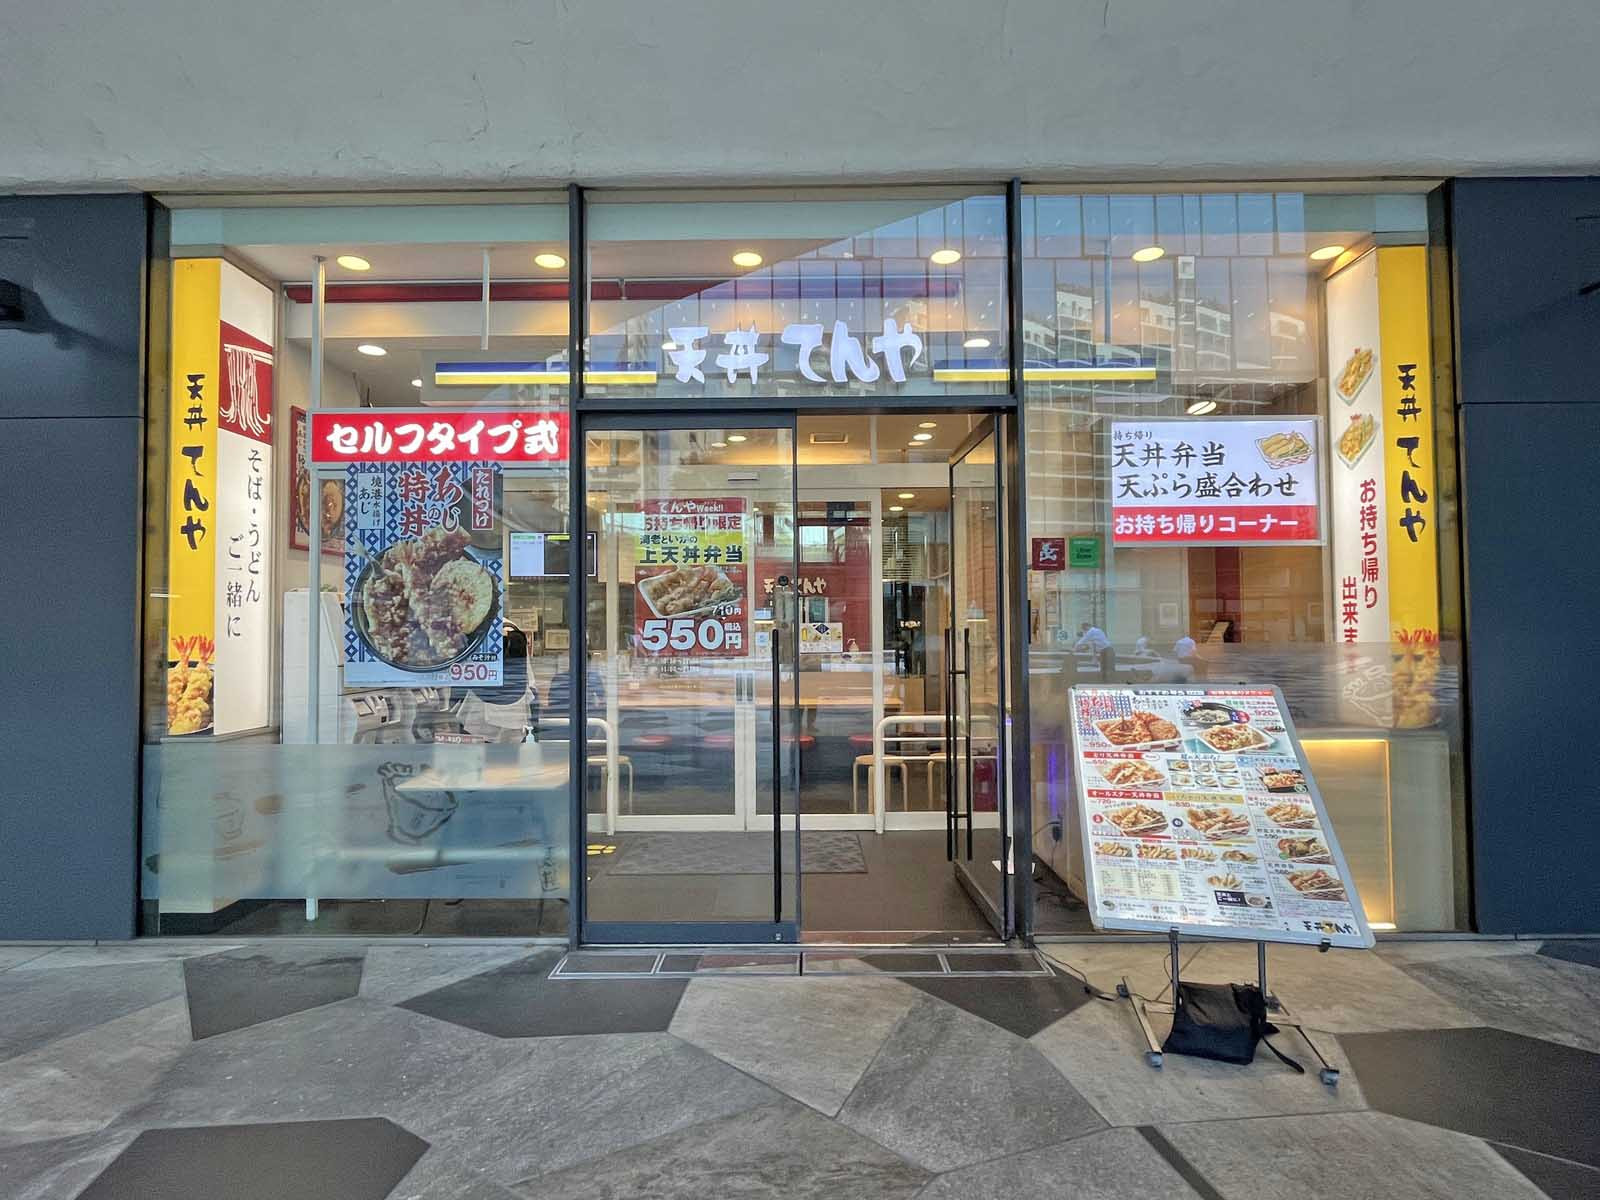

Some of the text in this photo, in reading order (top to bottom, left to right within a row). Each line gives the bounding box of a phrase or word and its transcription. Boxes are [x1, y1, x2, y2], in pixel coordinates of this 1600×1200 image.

[326, 419, 560, 454] セルフタイプ式
[1112, 430, 1153, 440] 持ち帰り
[1112, 441, 1226, 468] 天丼弁当
[475, 470, 491, 528] たれつけ
[1116, 472, 1299, 499] 天ぷら盛合わせ
[1115, 513, 1299, 535] お持ち帰りコーナー
[639, 545, 743, 563] 上天丼弁当
[1359, 478, 1379, 609] お持ち帰り
[226, 534, 244, 639] ご一緒に
